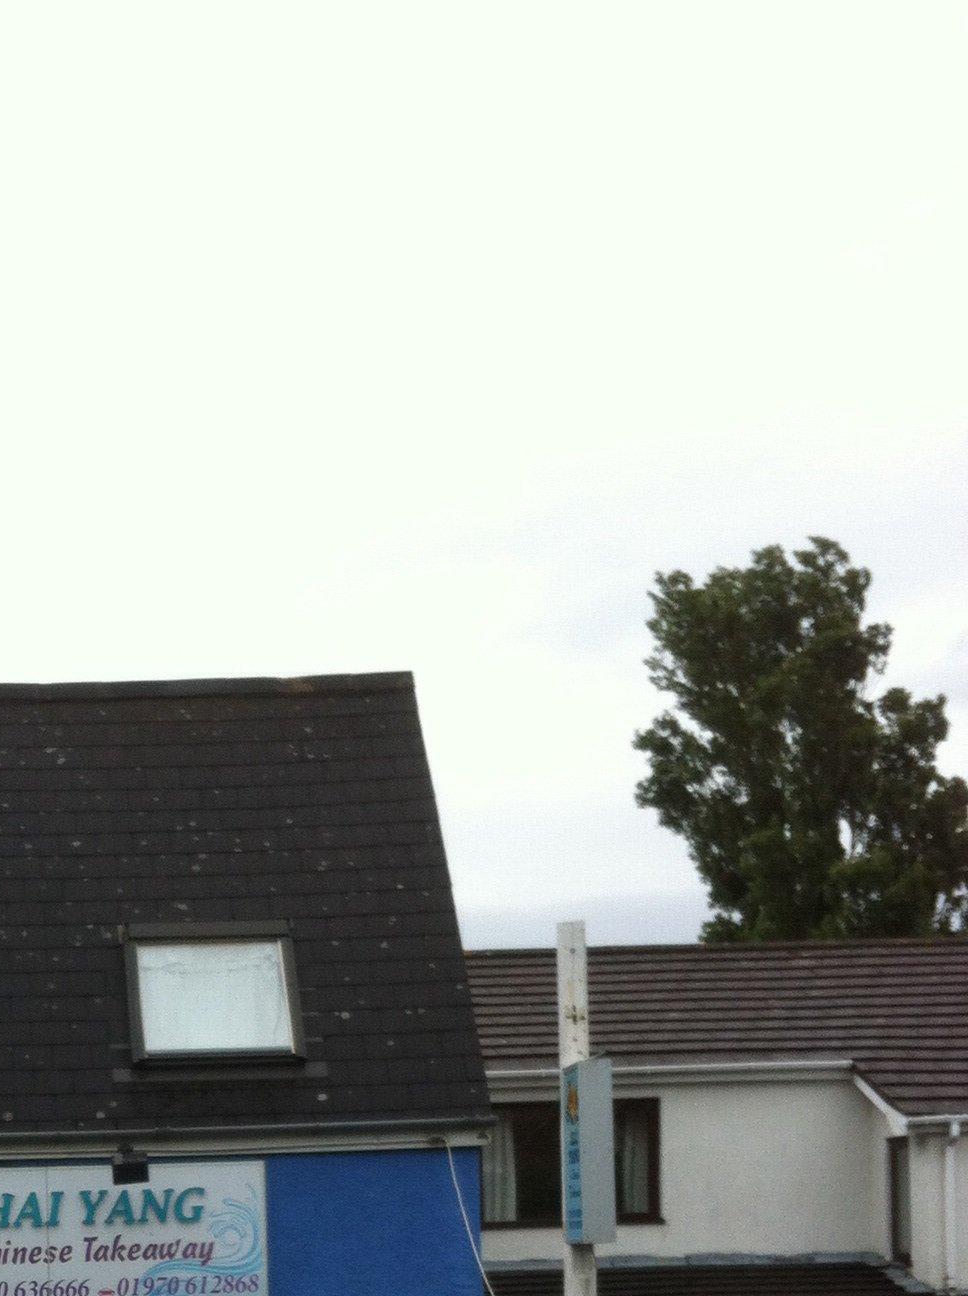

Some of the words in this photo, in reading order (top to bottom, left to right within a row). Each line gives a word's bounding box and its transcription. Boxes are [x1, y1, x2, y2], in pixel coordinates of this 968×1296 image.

[79, 1186, 206, 1226] YANG
[83, 1234, 215, 1267] Takeaway
[117, 1276, 180, 1296] 01970
[185, 1274, 260, 1295] 612868
